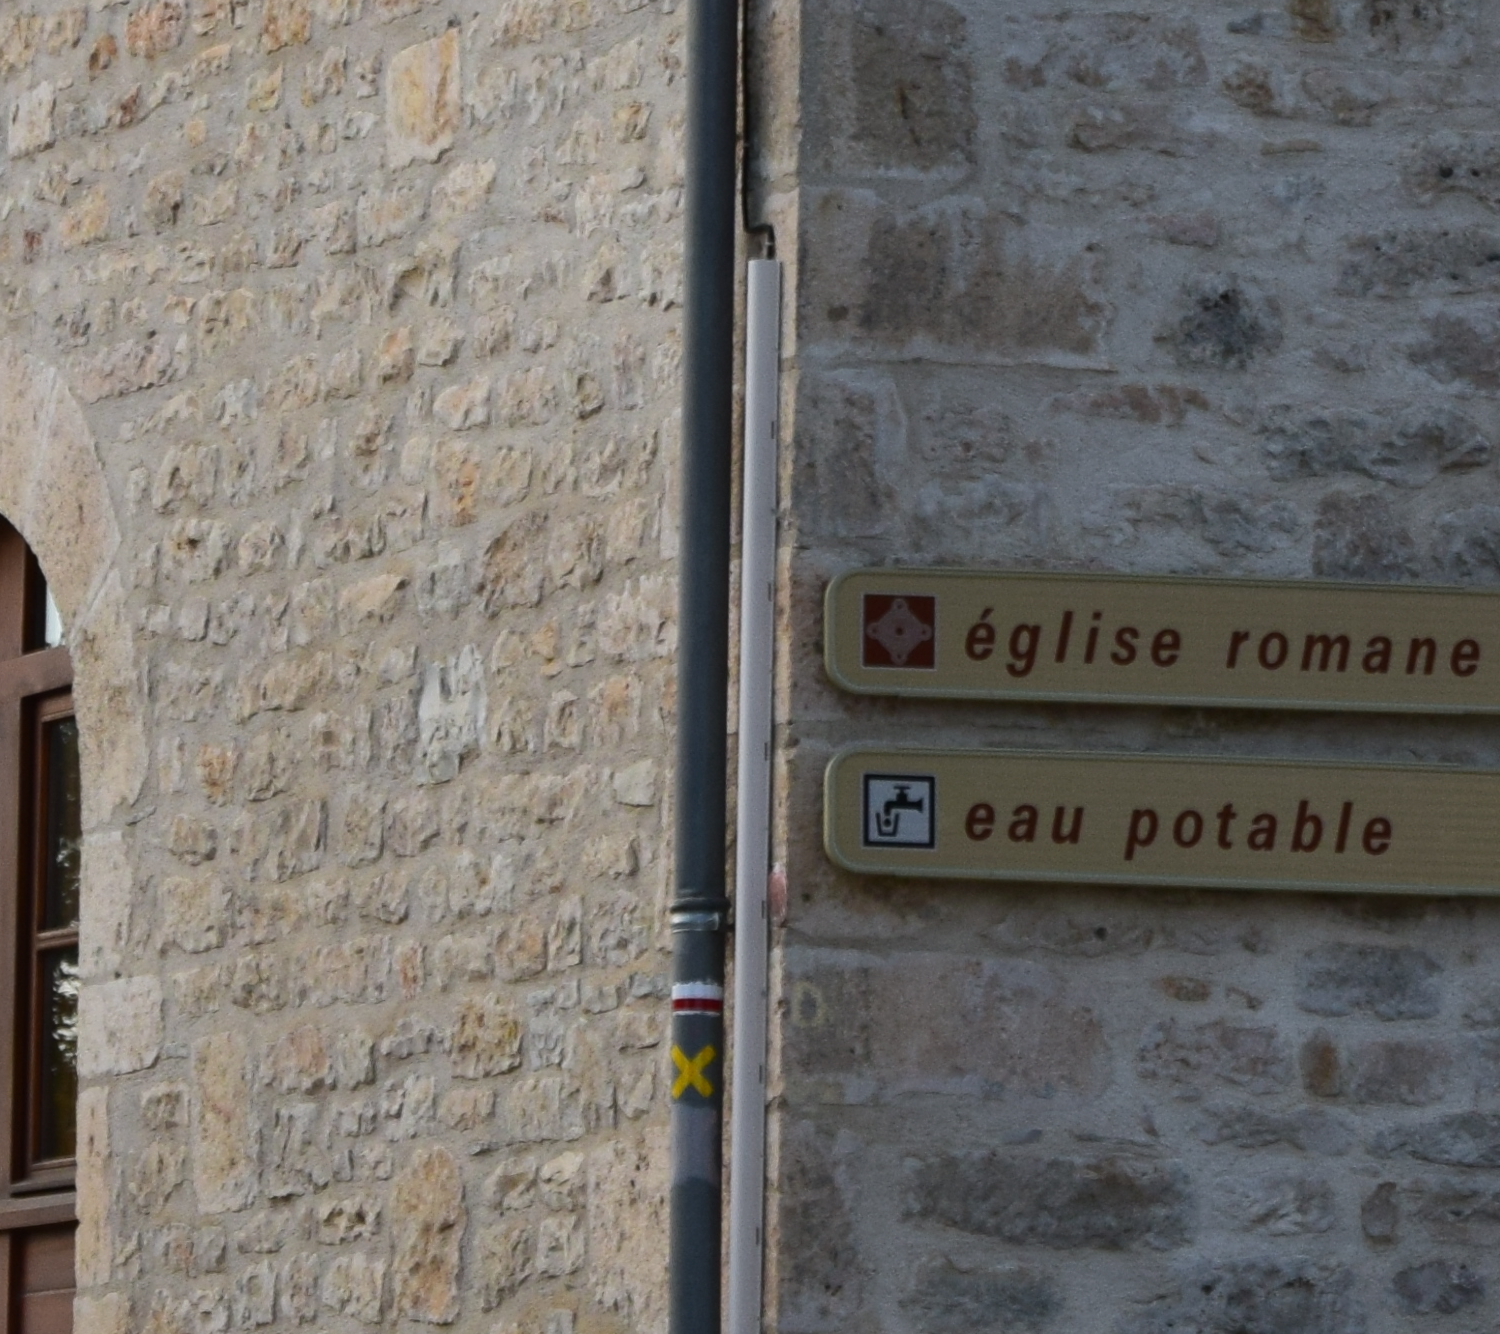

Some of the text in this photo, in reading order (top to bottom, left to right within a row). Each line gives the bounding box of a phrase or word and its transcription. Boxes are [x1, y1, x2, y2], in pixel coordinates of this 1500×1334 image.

[965, 607, 1482, 678] église romane
[965, 799, 1393, 861] eau potable
